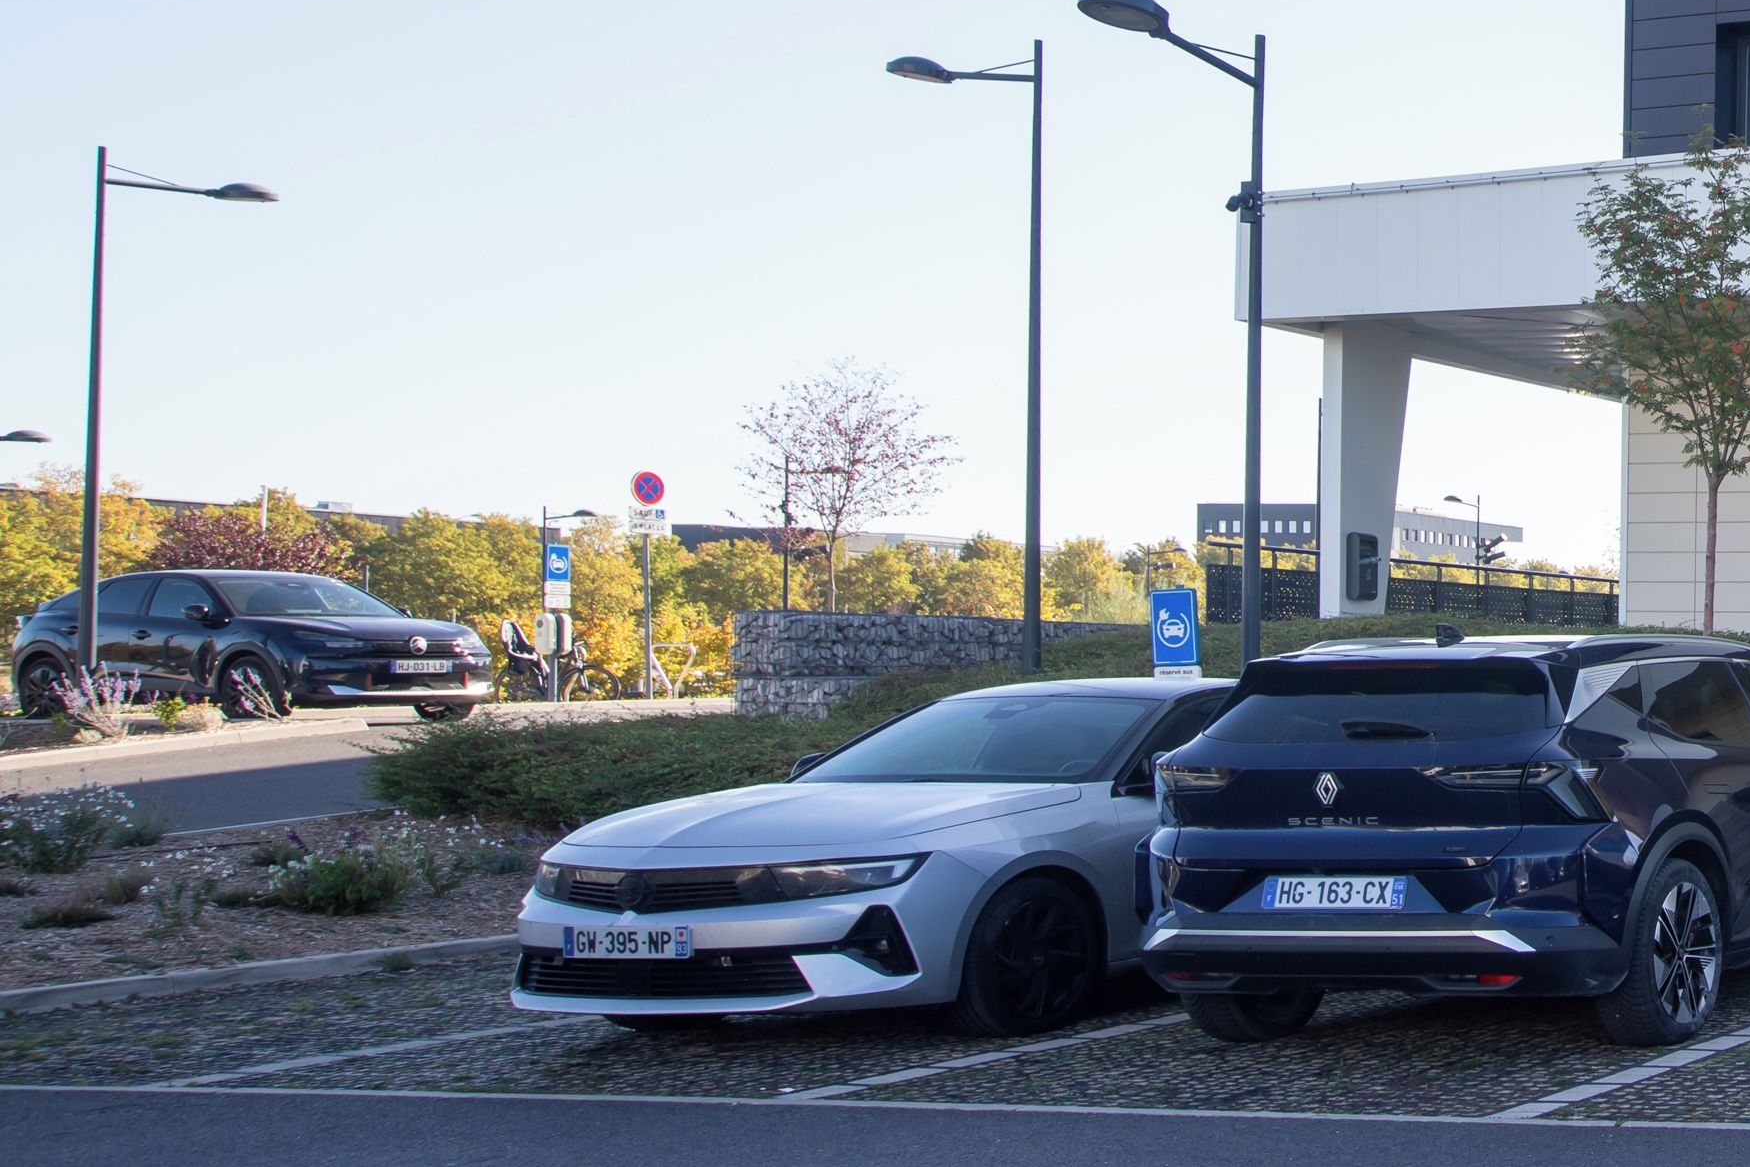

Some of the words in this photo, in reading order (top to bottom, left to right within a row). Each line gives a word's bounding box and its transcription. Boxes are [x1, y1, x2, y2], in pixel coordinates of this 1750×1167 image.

[1288, 817, 1379, 826] SCENIC
[1278, 881, 1391, 905] HG-163-CX
[1392, 893, 1404, 905] 51
[576, 930, 672, 954] GW-395-NP
[676, 943, 687, 954] 93
